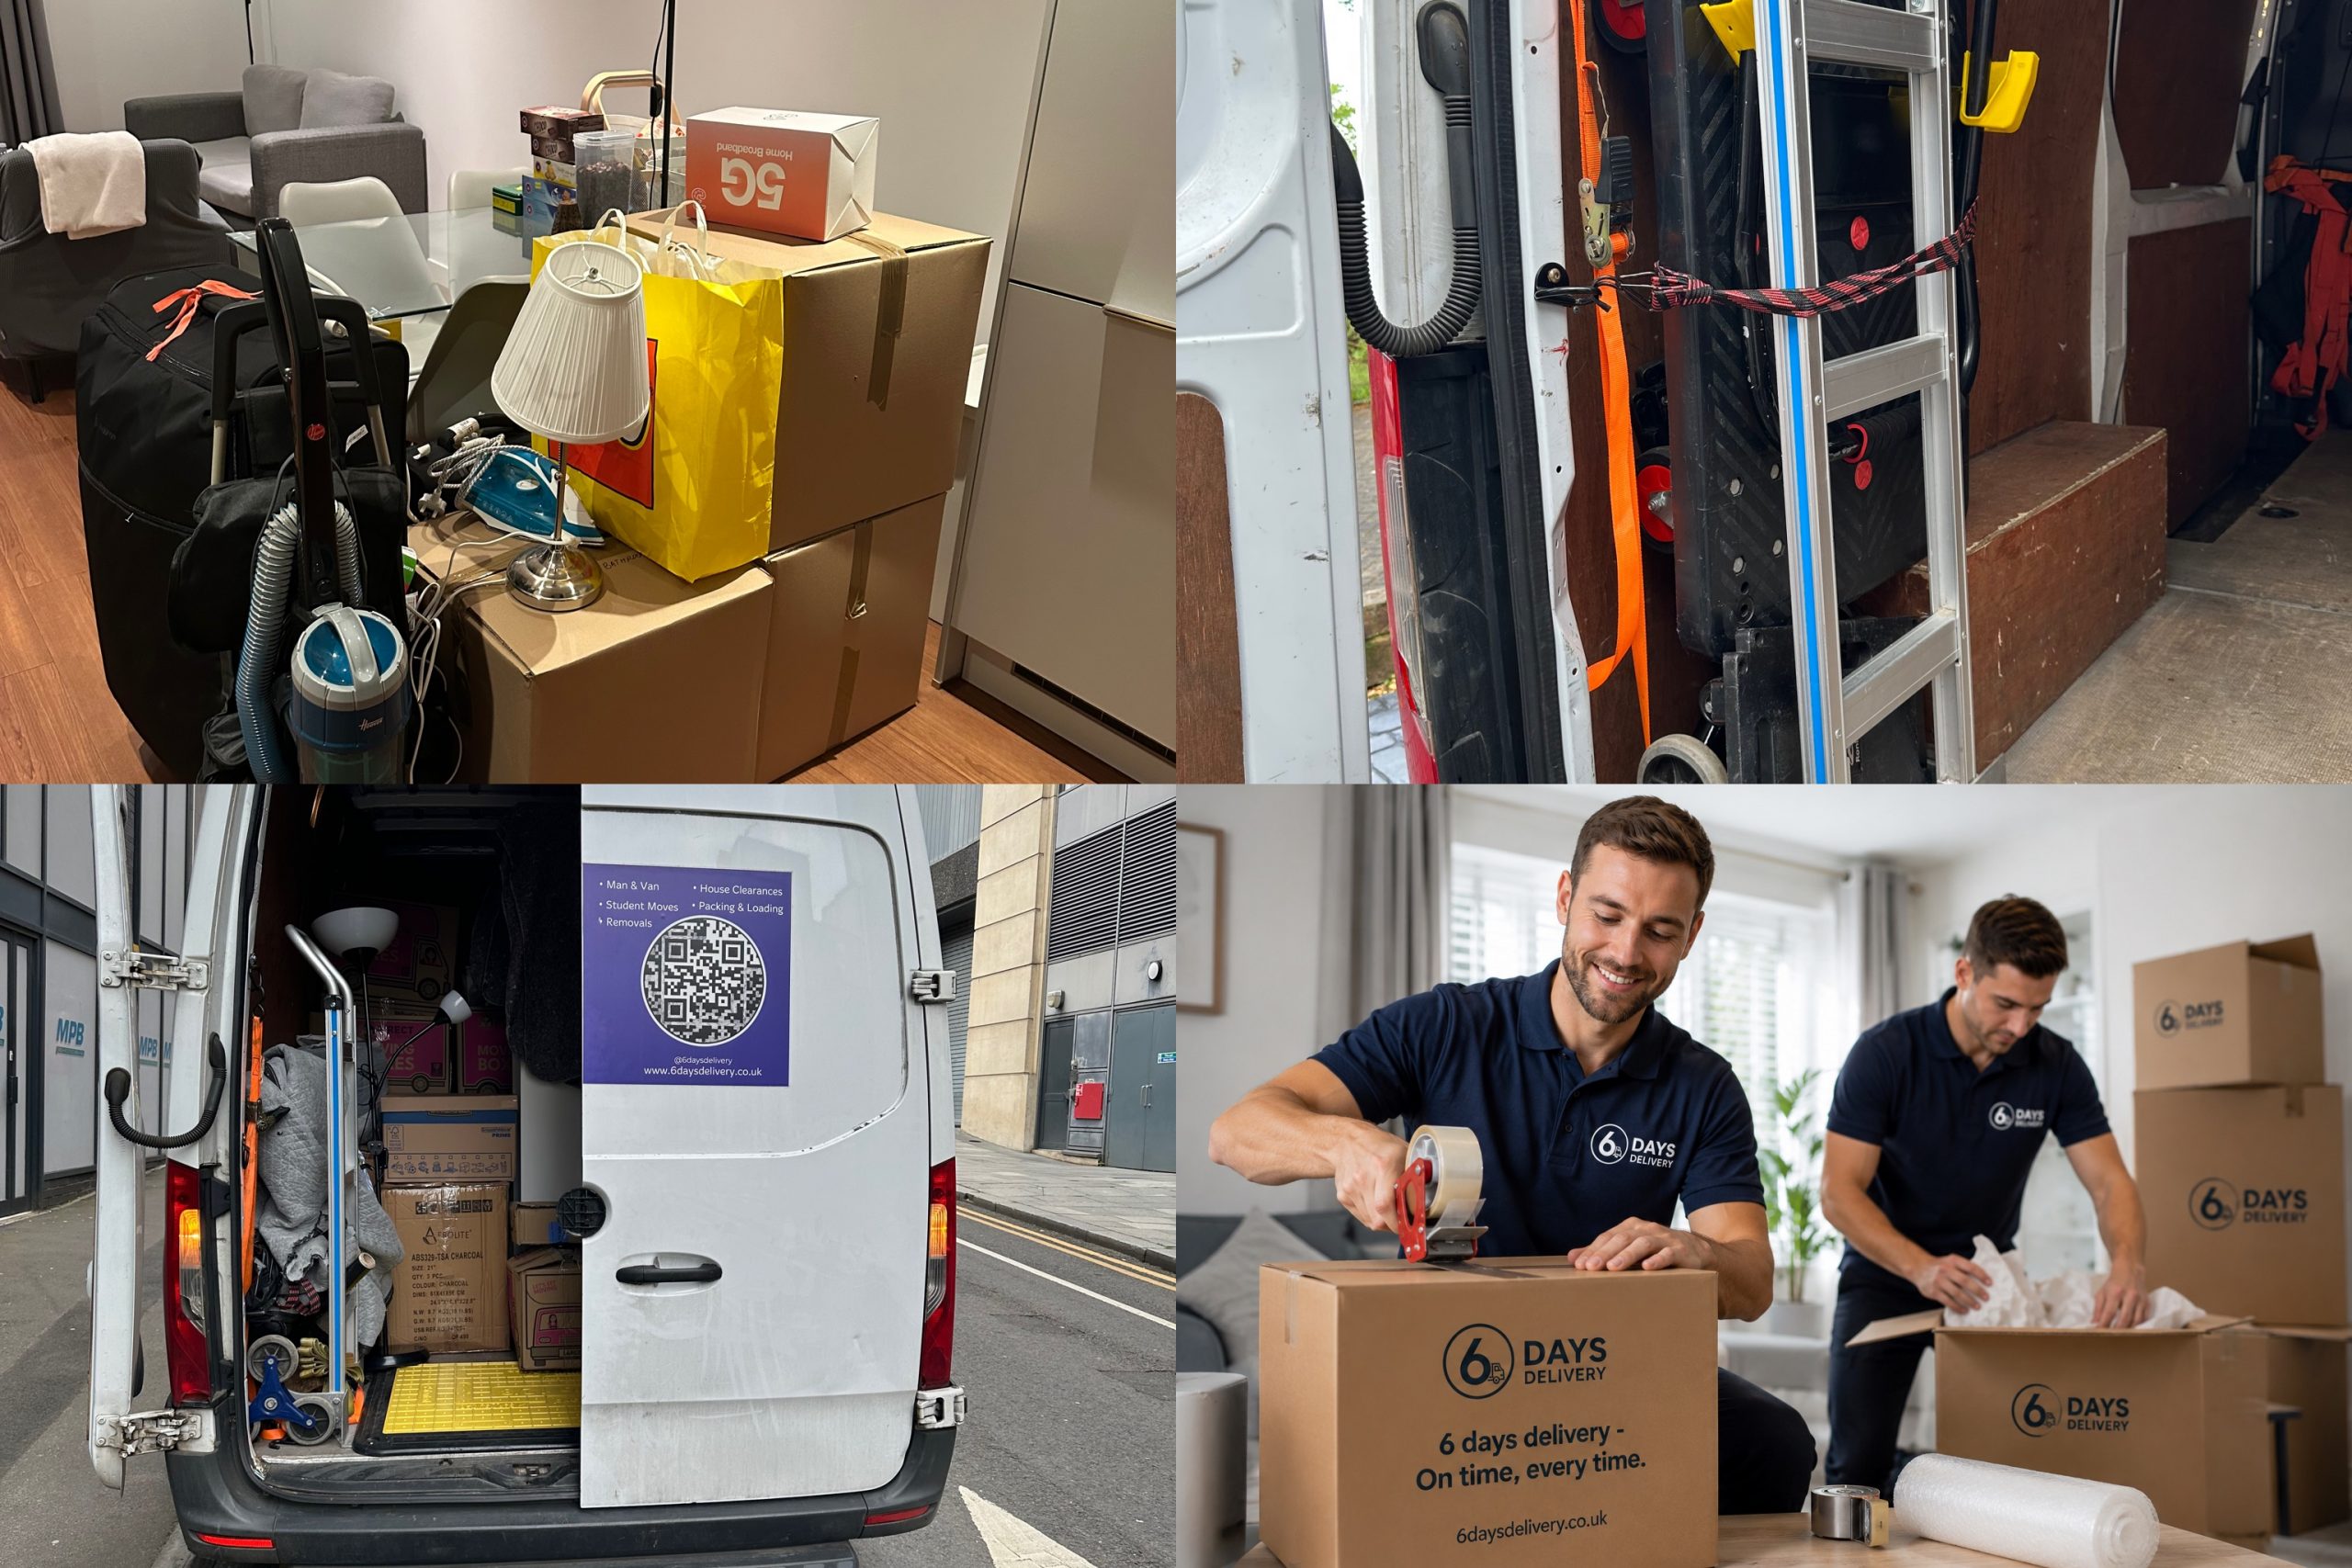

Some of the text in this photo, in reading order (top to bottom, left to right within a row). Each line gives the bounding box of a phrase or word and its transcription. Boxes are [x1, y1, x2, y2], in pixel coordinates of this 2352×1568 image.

[717, 142, 793, 162] Home Broadband
[721, 157, 786, 210] 5G
[606, 880, 660, 891] Man & Van
[700, 885, 783, 896] House Clearances
[605, 900, 679, 912] Student Moves
[698, 901, 784, 915] Packing & Loading
[606, 918, 652, 928] Removals
[2160, 999, 2223, 1031] 6 DAYS
[56, 1018, 85, 1045] MPB
[139, 1036, 158, 1057] MPB
[673, 1056, 733, 1066] @6daysdelivery
[643, 1066, 763, 1077] www.6daysdelivery.co.uk
[1994, 1106, 2045, 1125] 6 DAYS
[1599, 1131, 1677, 1157] 6 DAYS
[1629, 1154, 1674, 1168] DELIVERY
[2200, 1187, 2308, 1221] 6 DAYS
[2244, 1212, 2308, 1223] DELIVERY
[451, 1251, 483, 1260] CHARCOAL
[1460, 1337, 1607, 1385] 6 DAYS
[1524, 1367, 1606, 1384] DELIVERY
[2024, 1393, 2129, 1427] 6 DAYS
[2067, 1419, 2130, 1431] DELIVERY
[1440, 1433, 1455, 1455] 6
[1462, 1430, 1518, 1457] days
[1523, 1424, 1611, 1447] delivery
[1416, 1450, 1645, 1491] On time, every time.
[1456, 1510, 1608, 1544] 6daysdelivery.co.uk
